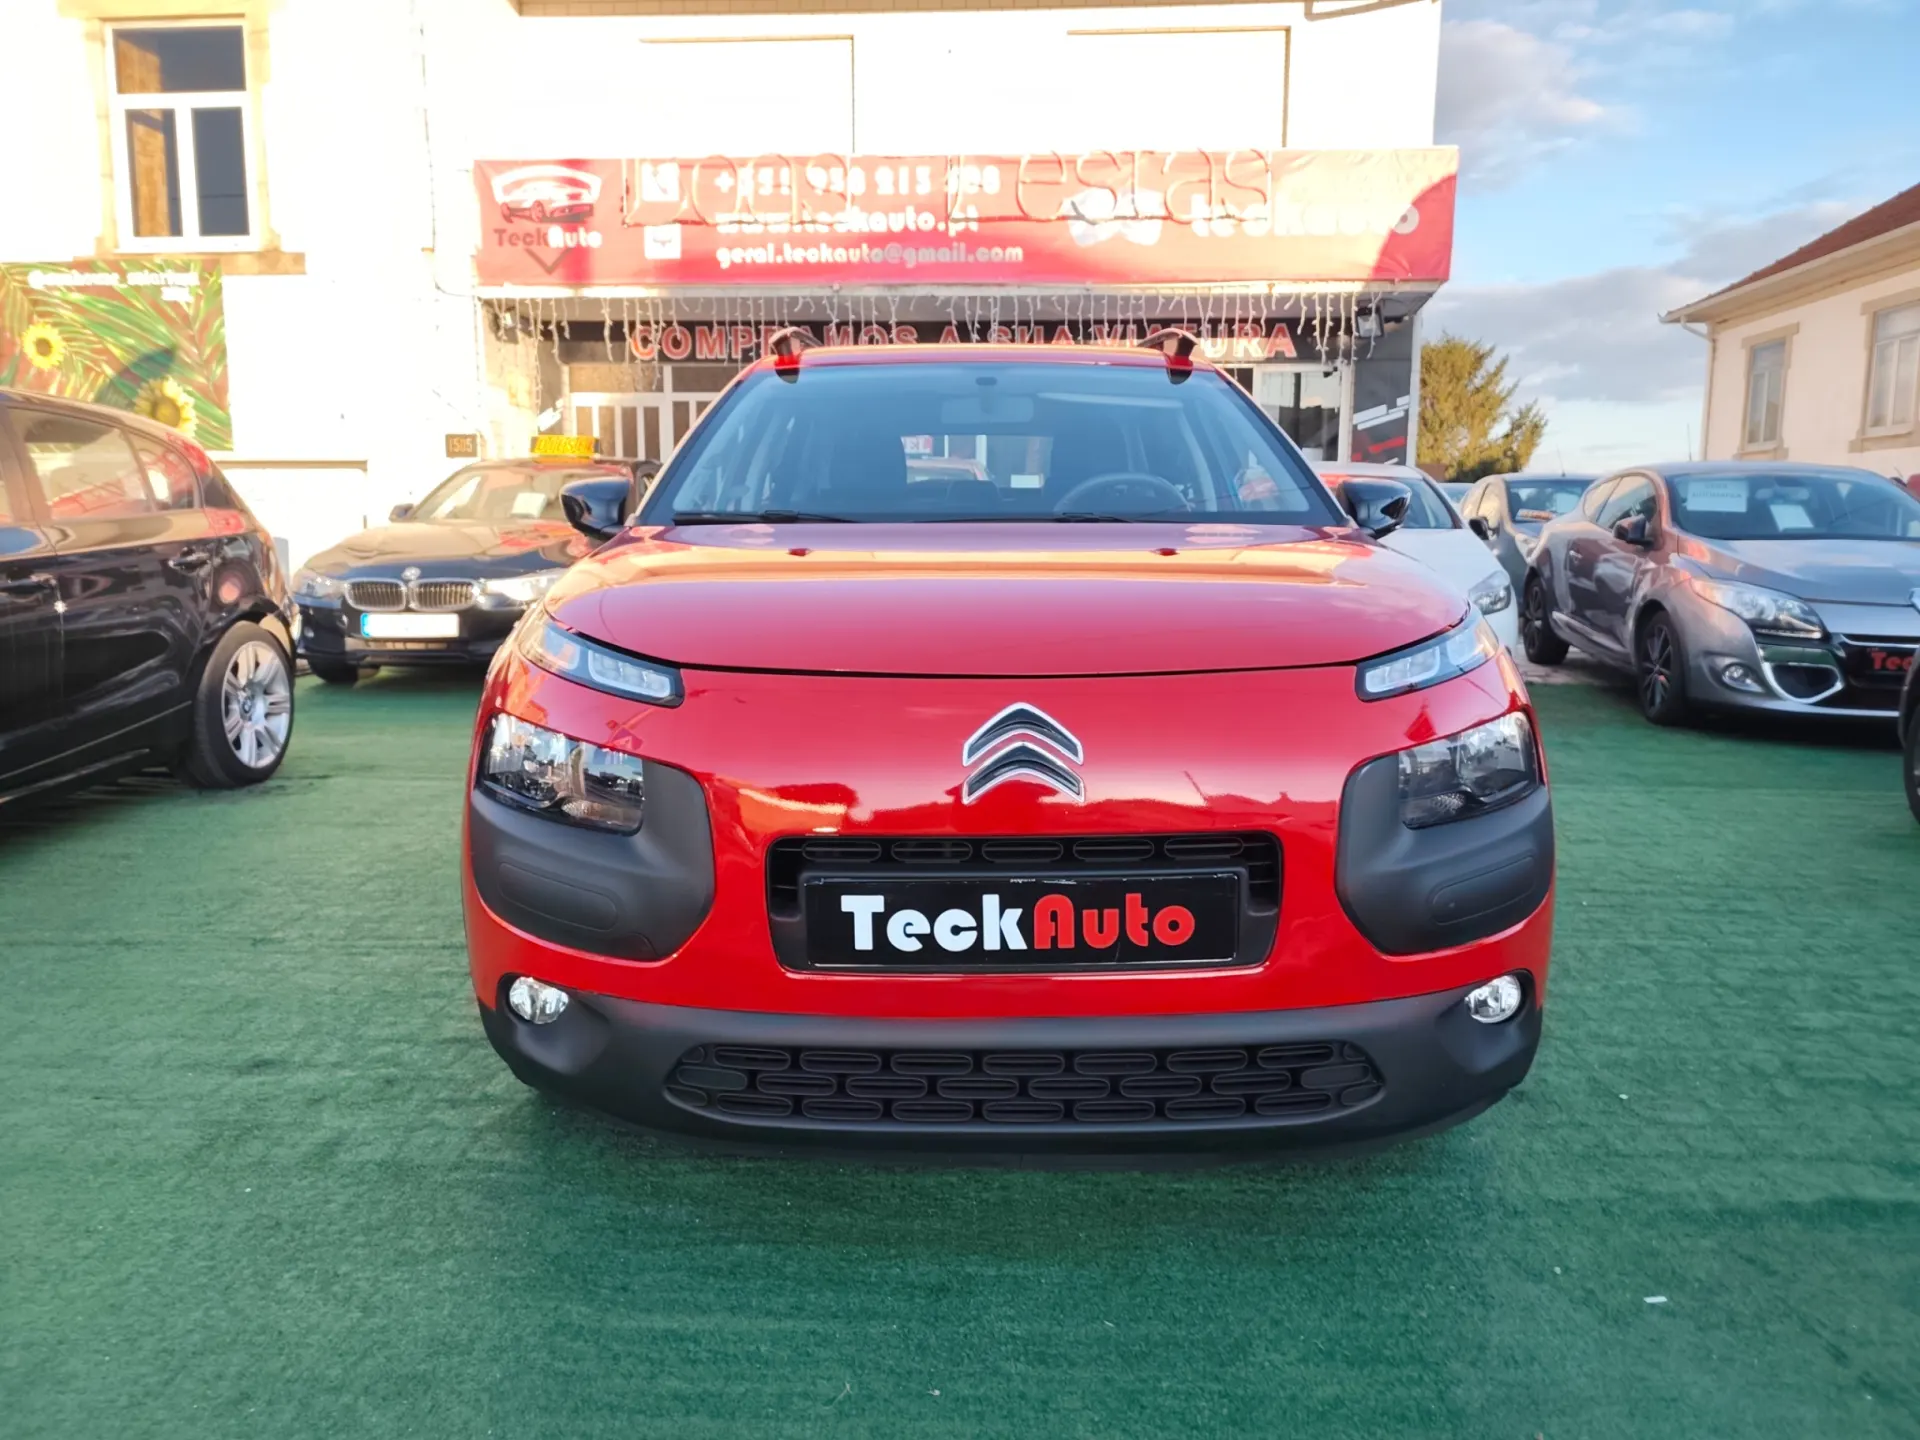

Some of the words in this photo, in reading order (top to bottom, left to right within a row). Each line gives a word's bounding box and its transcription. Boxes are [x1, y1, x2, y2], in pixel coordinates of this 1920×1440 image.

[493, 224, 604, 249] TeckAuto
[716, 242, 1024, 269] geral.teckauto@gmail.com
[840, 893, 1196, 952] TeckAuto
